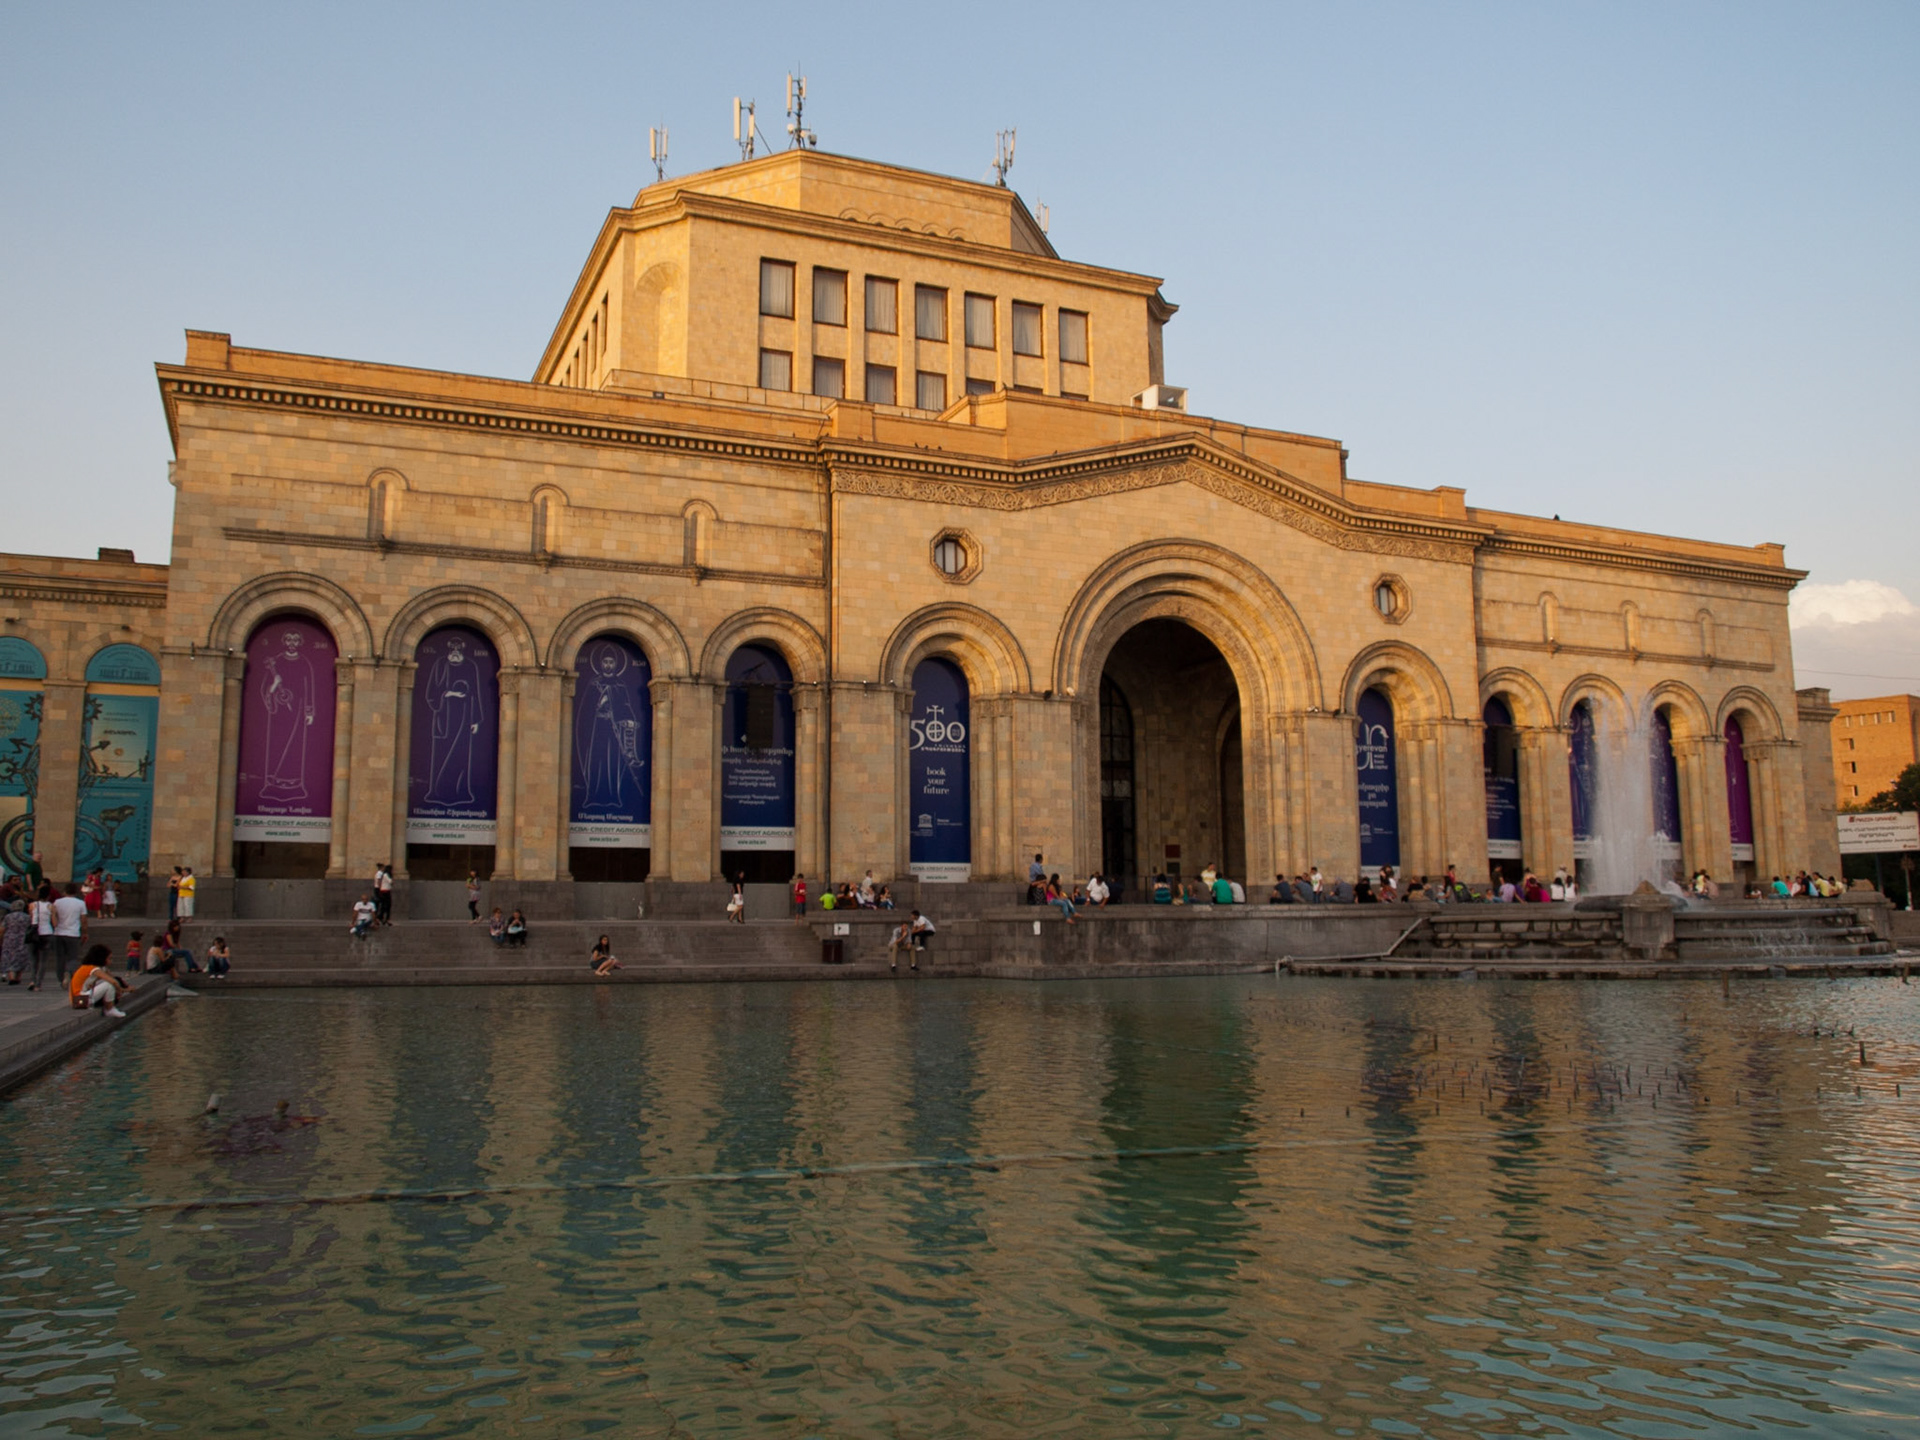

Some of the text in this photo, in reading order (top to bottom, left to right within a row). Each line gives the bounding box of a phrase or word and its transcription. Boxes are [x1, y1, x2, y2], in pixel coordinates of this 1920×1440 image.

[909, 718, 966, 751] 500
[926, 766, 946, 776] book
[927, 778, 946, 787] your
[923, 785, 950, 795] future
